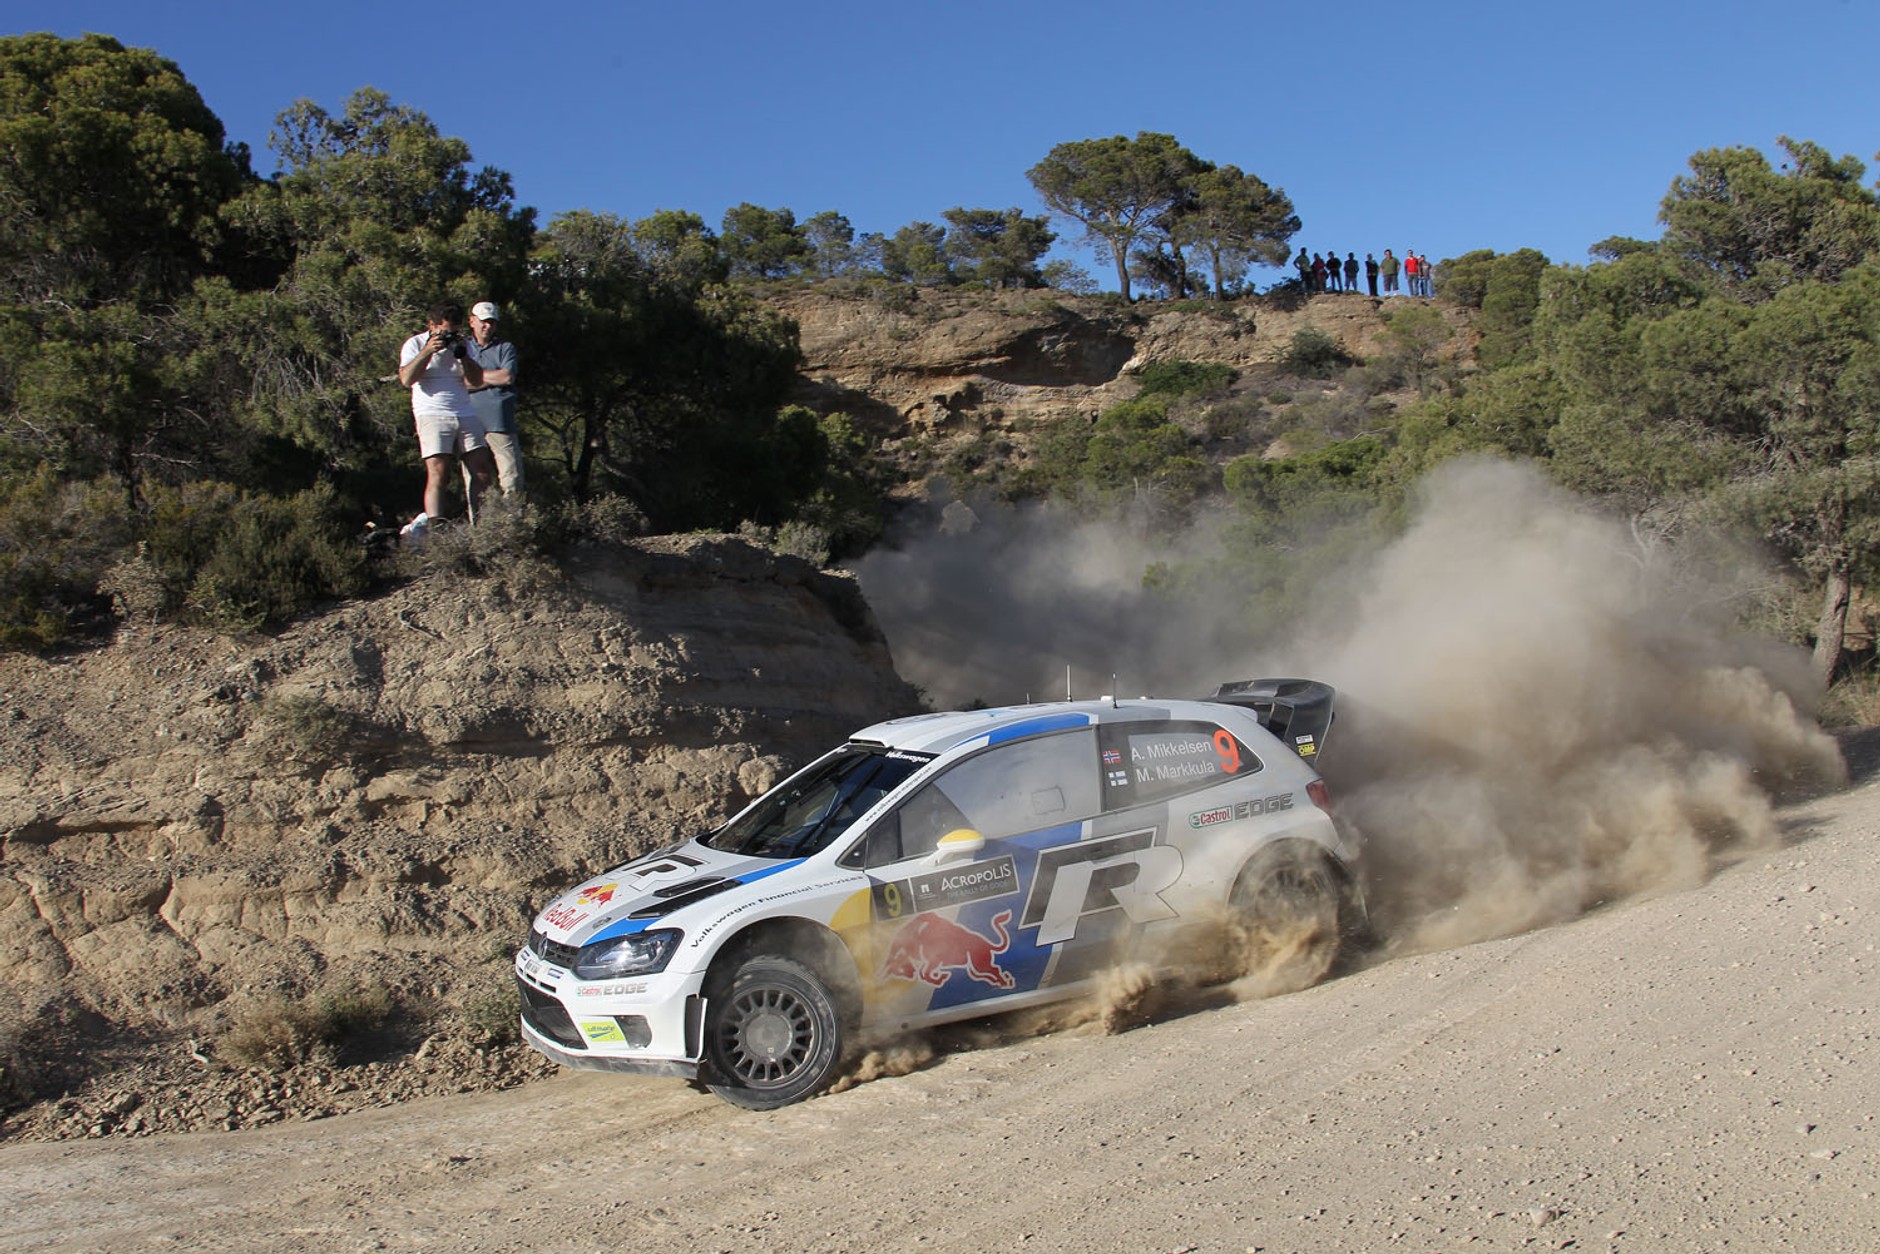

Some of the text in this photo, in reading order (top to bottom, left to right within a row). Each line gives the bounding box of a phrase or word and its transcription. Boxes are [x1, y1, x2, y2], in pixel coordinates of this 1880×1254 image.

[1131, 741, 1212, 761] A. Mikkelsen
[1213, 729, 1240, 774] 9
[1135, 760, 1215, 783] M. Markkula
[1200, 792, 1294, 825] Castrol EDGE
[941, 863, 1012, 892] ACROPOLIS
[1018, 826, 1184, 947] R
[690, 875, 864, 948] Volkswagen Financial Services
[883, 883, 902, 917] 9
[559, 908, 591, 932] Bull
[603, 982, 648, 995] EDGE
